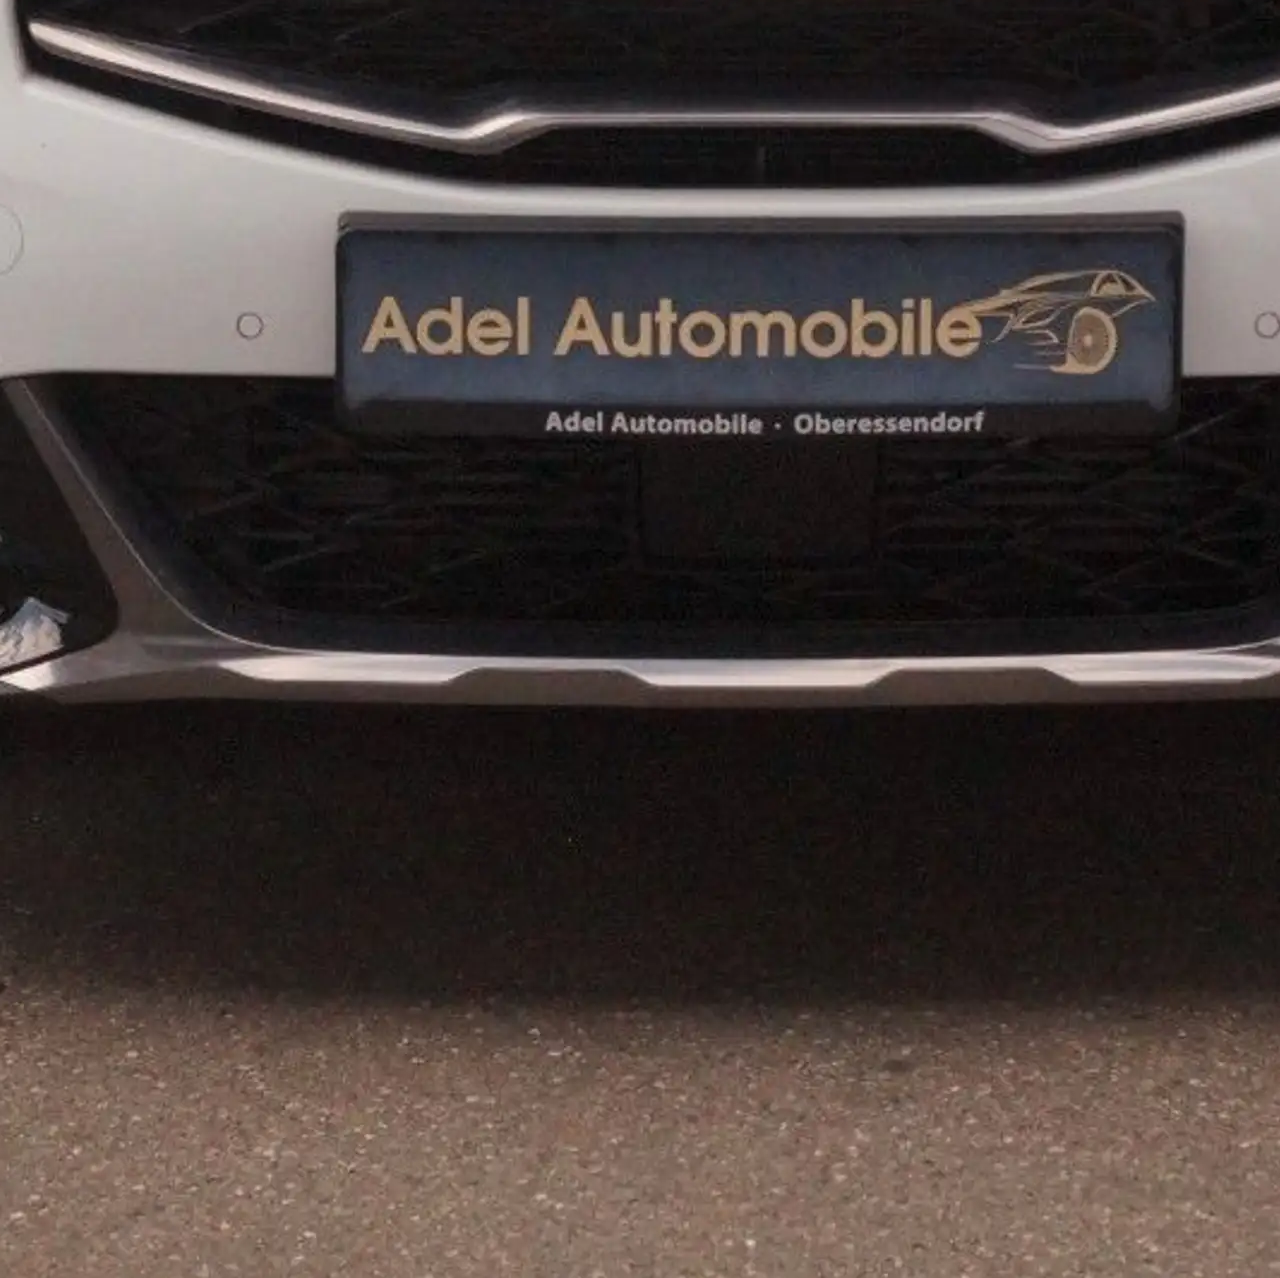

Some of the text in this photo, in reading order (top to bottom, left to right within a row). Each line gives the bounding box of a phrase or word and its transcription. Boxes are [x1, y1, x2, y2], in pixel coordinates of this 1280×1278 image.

[361, 295, 983, 359] Adel Automobile
[545, 411, 985, 435] Adel Automobile Oberessendorf
